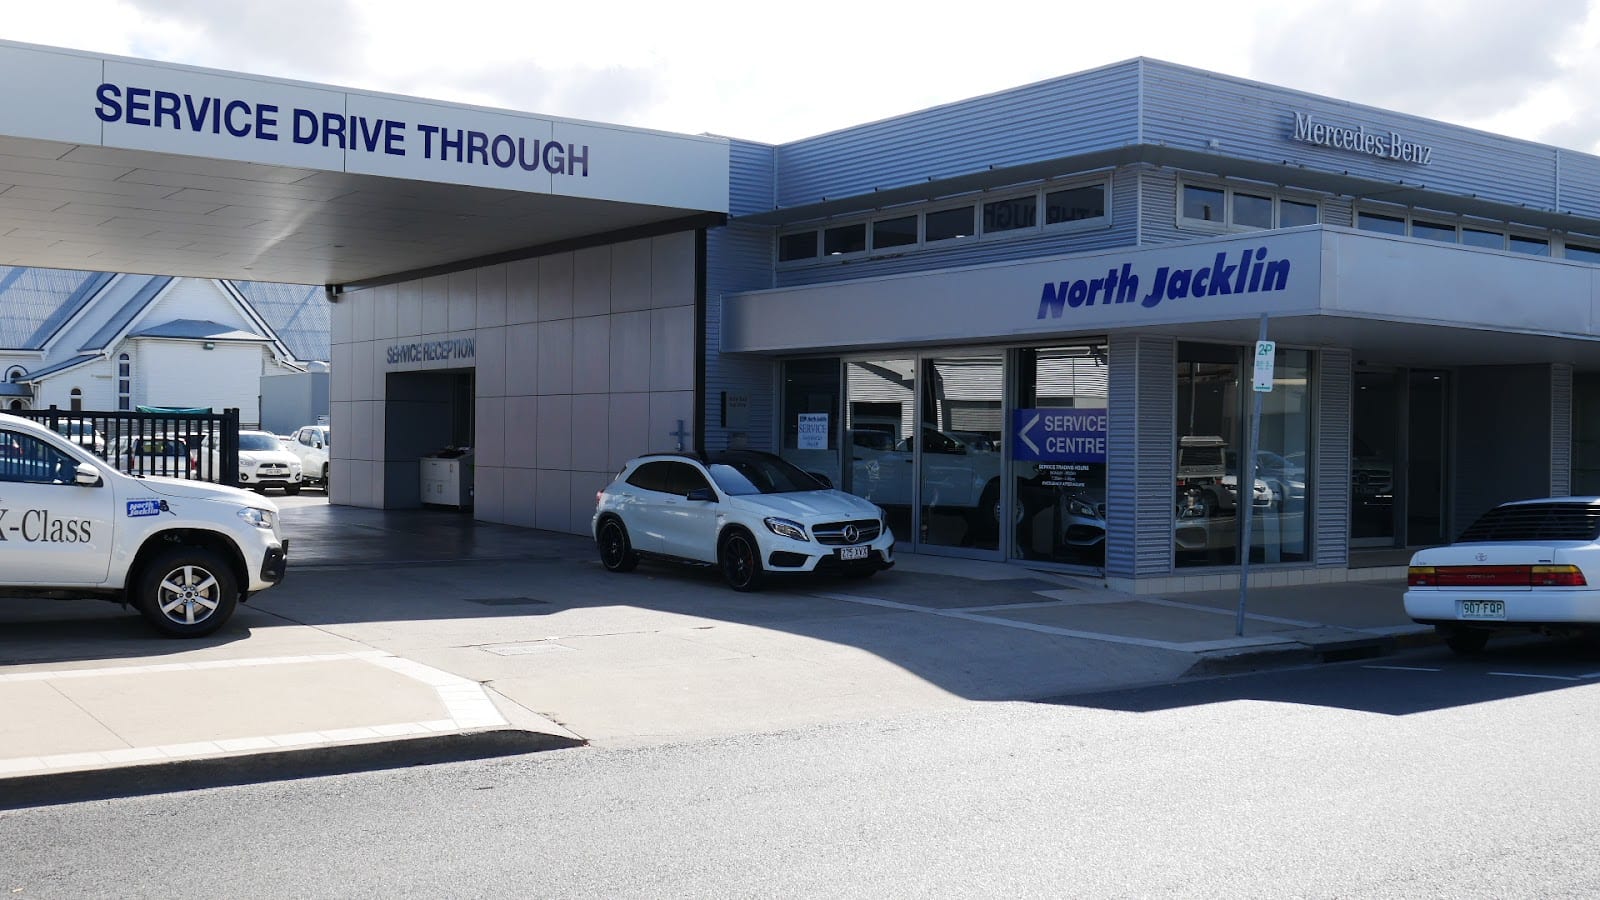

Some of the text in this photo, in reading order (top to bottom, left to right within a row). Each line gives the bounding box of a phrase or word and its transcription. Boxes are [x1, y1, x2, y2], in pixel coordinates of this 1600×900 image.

[95, 83, 589, 177] SERVICE DRIVE THROUGH
[1293, 111, 1432, 165] Mercedes-Benz
[1037, 246, 1290, 320] North Jacklin
[387, 338, 475, 364] SERVICE RECEPTION
[1258, 343, 1273, 356] 2P
[1044, 415, 1107, 432] SERVICE
[1046, 437, 1105, 454] CENTRE
